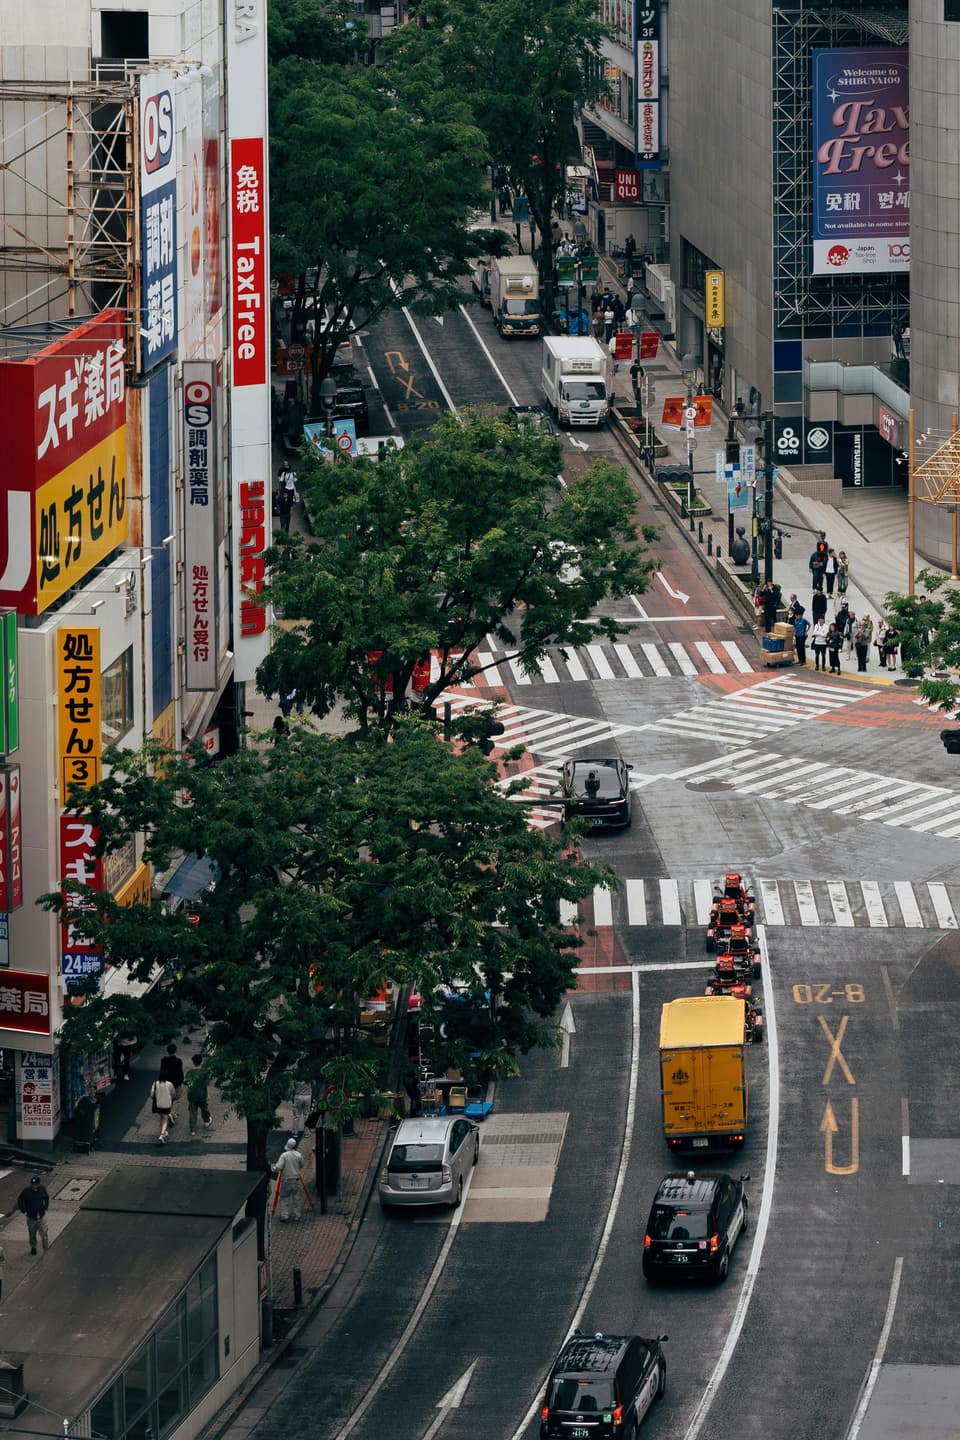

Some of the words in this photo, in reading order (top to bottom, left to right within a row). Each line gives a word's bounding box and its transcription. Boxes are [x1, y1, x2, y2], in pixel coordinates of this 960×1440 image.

[642, 27, 654, 38] 3F
[643, 50, 653, 89] カラオケ
[837, 76, 900, 86] SHIBUYA109
[843, 69, 887, 77] Welcome
[888, 68, 898, 76] to
[144, 92, 173, 165] OS
[236, 165, 260, 214] 免税
[618, 173, 637, 185] UNI
[619, 185, 638, 198] QLO
[826, 192, 860, 211] 免税
[146, 194, 173, 276] 調剤
[838, 221, 867, 229] available
[146, 273, 175, 357] 薬局
[37, 338, 127, 460] スギ薬局
[186, 382, 211, 426] OS
[188, 428, 208, 506] 調剤薬局
[39, 455, 126, 590] 処方せん
[192, 565, 209, 662] 処方せん受付
[63, 633, 94, 755] 処方せん
[11, 826, 21, 881] アコム
[24, 1068, 48, 1080] 営業
[24, 1103, 51, 1115] 化粧品
[31, 1095, 43, 1103] 2F
